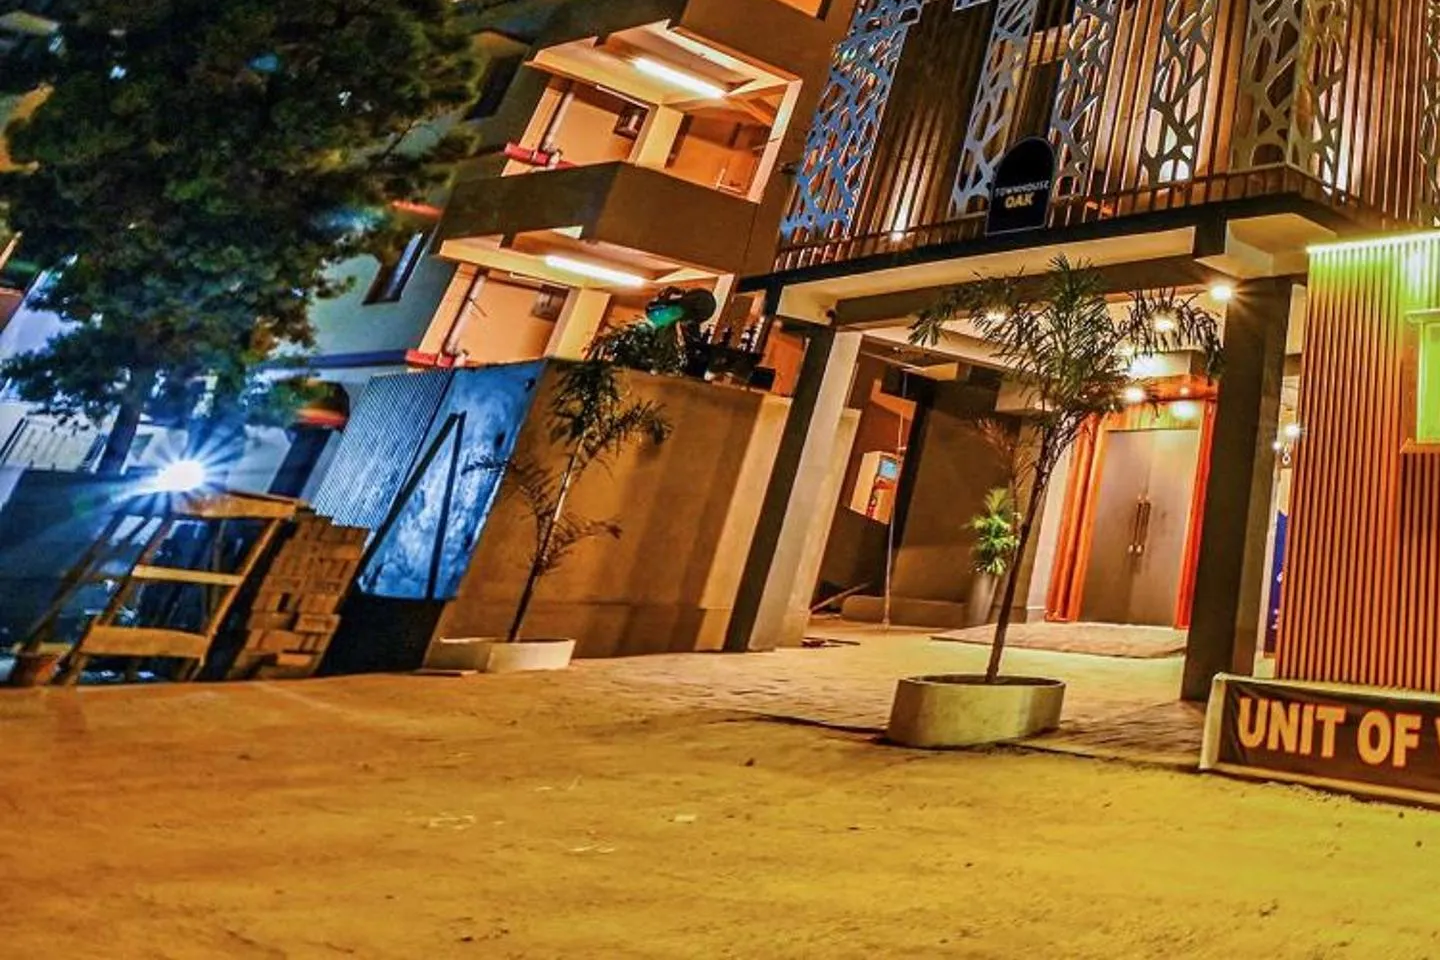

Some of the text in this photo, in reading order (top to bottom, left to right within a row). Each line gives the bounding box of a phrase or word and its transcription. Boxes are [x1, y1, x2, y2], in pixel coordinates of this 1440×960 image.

[1005, 192, 1034, 208] OAK
[1237, 697, 1346, 759] UNIT
[1357, 708, 1421, 769] OF
